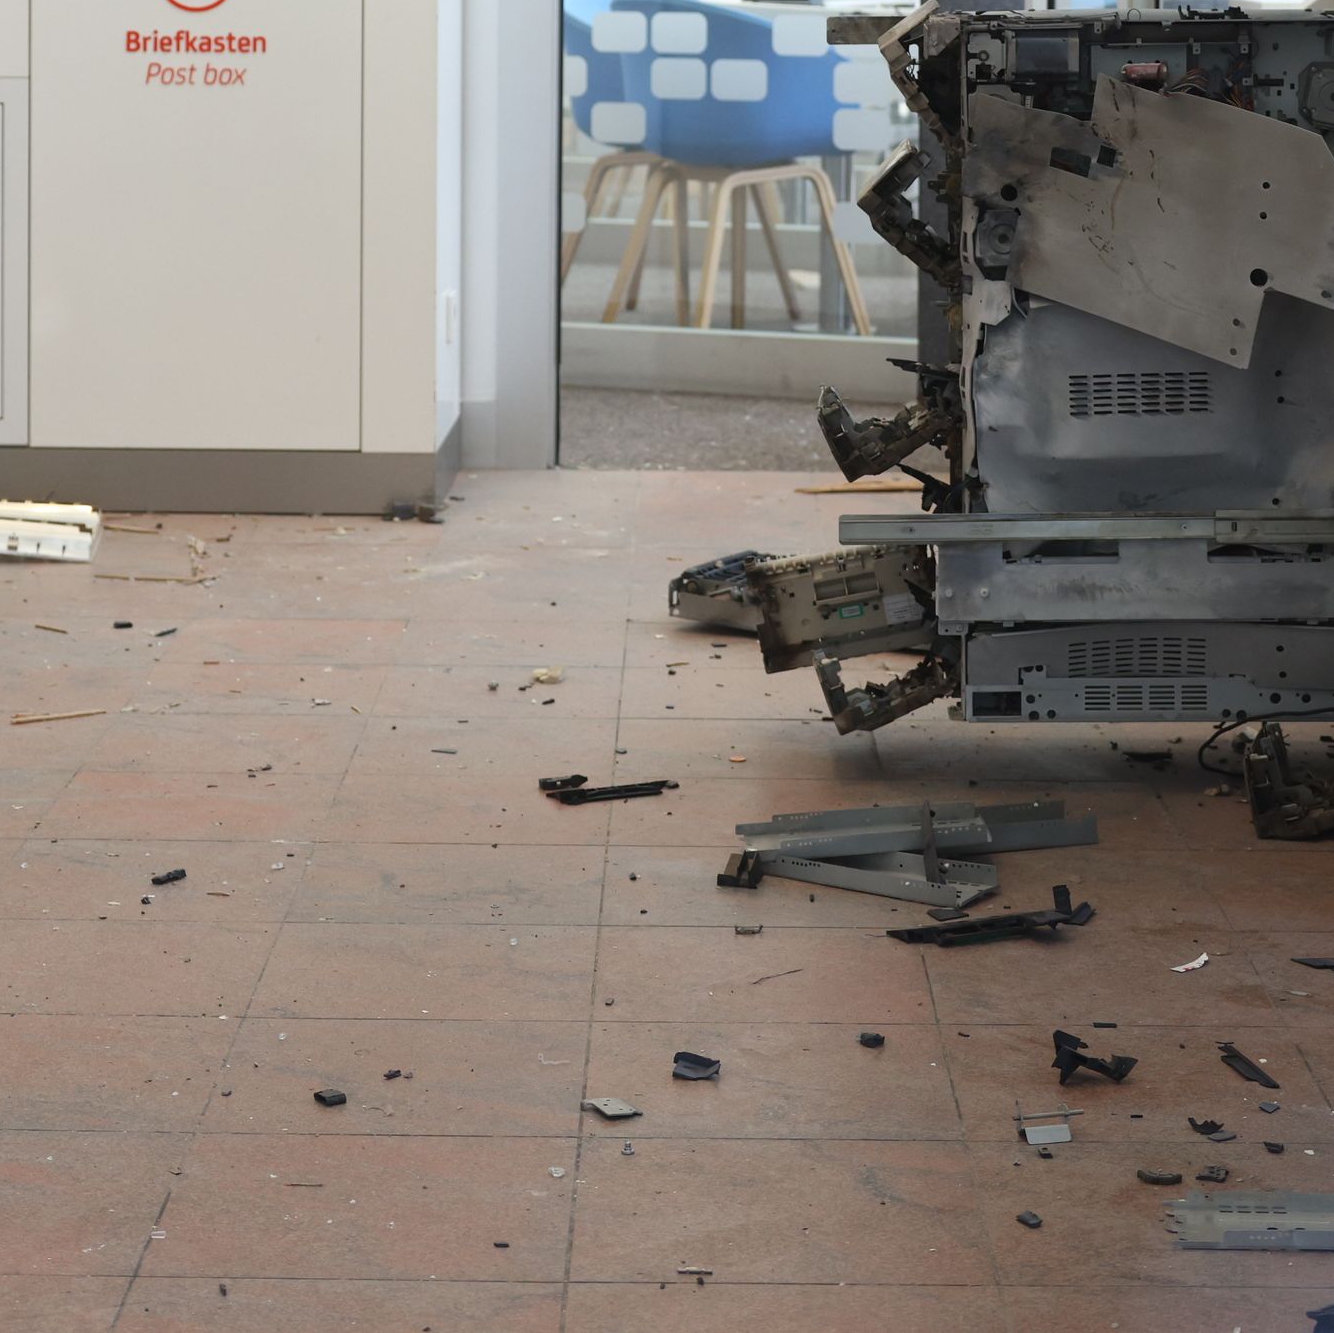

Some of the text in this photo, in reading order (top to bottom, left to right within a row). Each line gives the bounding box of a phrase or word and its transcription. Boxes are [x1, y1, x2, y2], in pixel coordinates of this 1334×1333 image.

[125, 30, 266, 53] Briefkasten
[145, 63, 247, 85] Post box
